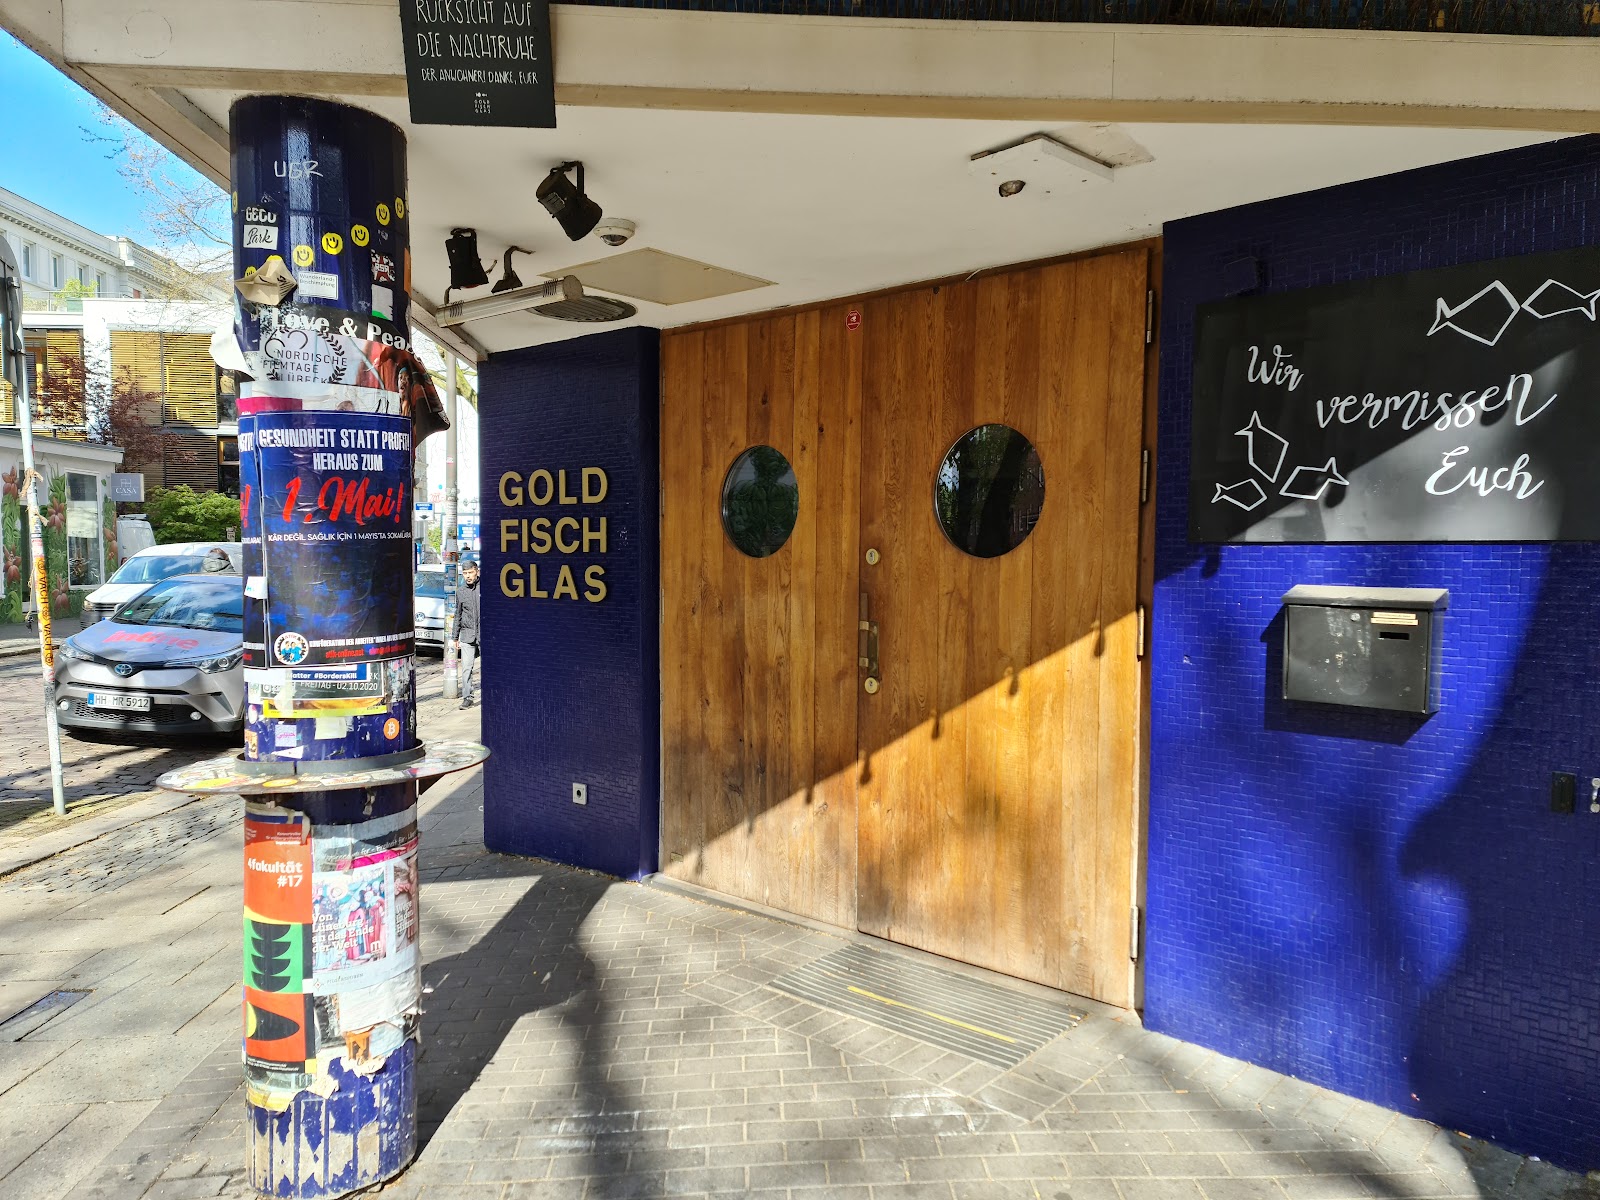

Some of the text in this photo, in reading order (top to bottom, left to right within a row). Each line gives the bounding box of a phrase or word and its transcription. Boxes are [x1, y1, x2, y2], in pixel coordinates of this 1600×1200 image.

[503, 1, 532, 26] AUF
[417, 32, 537, 60] DIE NACHTRUHE
[421, 68, 538, 85] DER ANWOHNER! DANKE, EUER
[246, 227, 273, 246] Park
[271, 307, 330, 334] Love
[338, 317, 358, 338] &
[276, 348, 348, 367] NORDISCHE
[1247, 344, 1304, 391] Wir
[1316, 373, 1557, 431] vermissen
[259, 428, 336, 448] GESUNDHEIT
[340, 429, 380, 449] STATT
[381, 431, 410, 451] PROFIT!
[313, 453, 383, 472] HERAUS ZUM
[1424, 446, 1544, 499] Euch
[498, 466, 609, 507] GOLD
[282, 476, 405, 526] 1. Mai!
[500, 516, 608, 554] FISCH
[499, 562, 608, 603] GLAS
[314, 671, 358, 679] #BordersKill
[300, 681, 332, 690] FREITAG
[337, 682, 378, 691] 02.10.2020
[95, 694, 149, 708] HH MR 5912
[276, 875, 303, 888] #17
[312, 913, 333, 923] Von
[328, 931, 347, 941] das
[349, 926, 374, 938] Ende
[312, 938, 358, 953] der Welt
